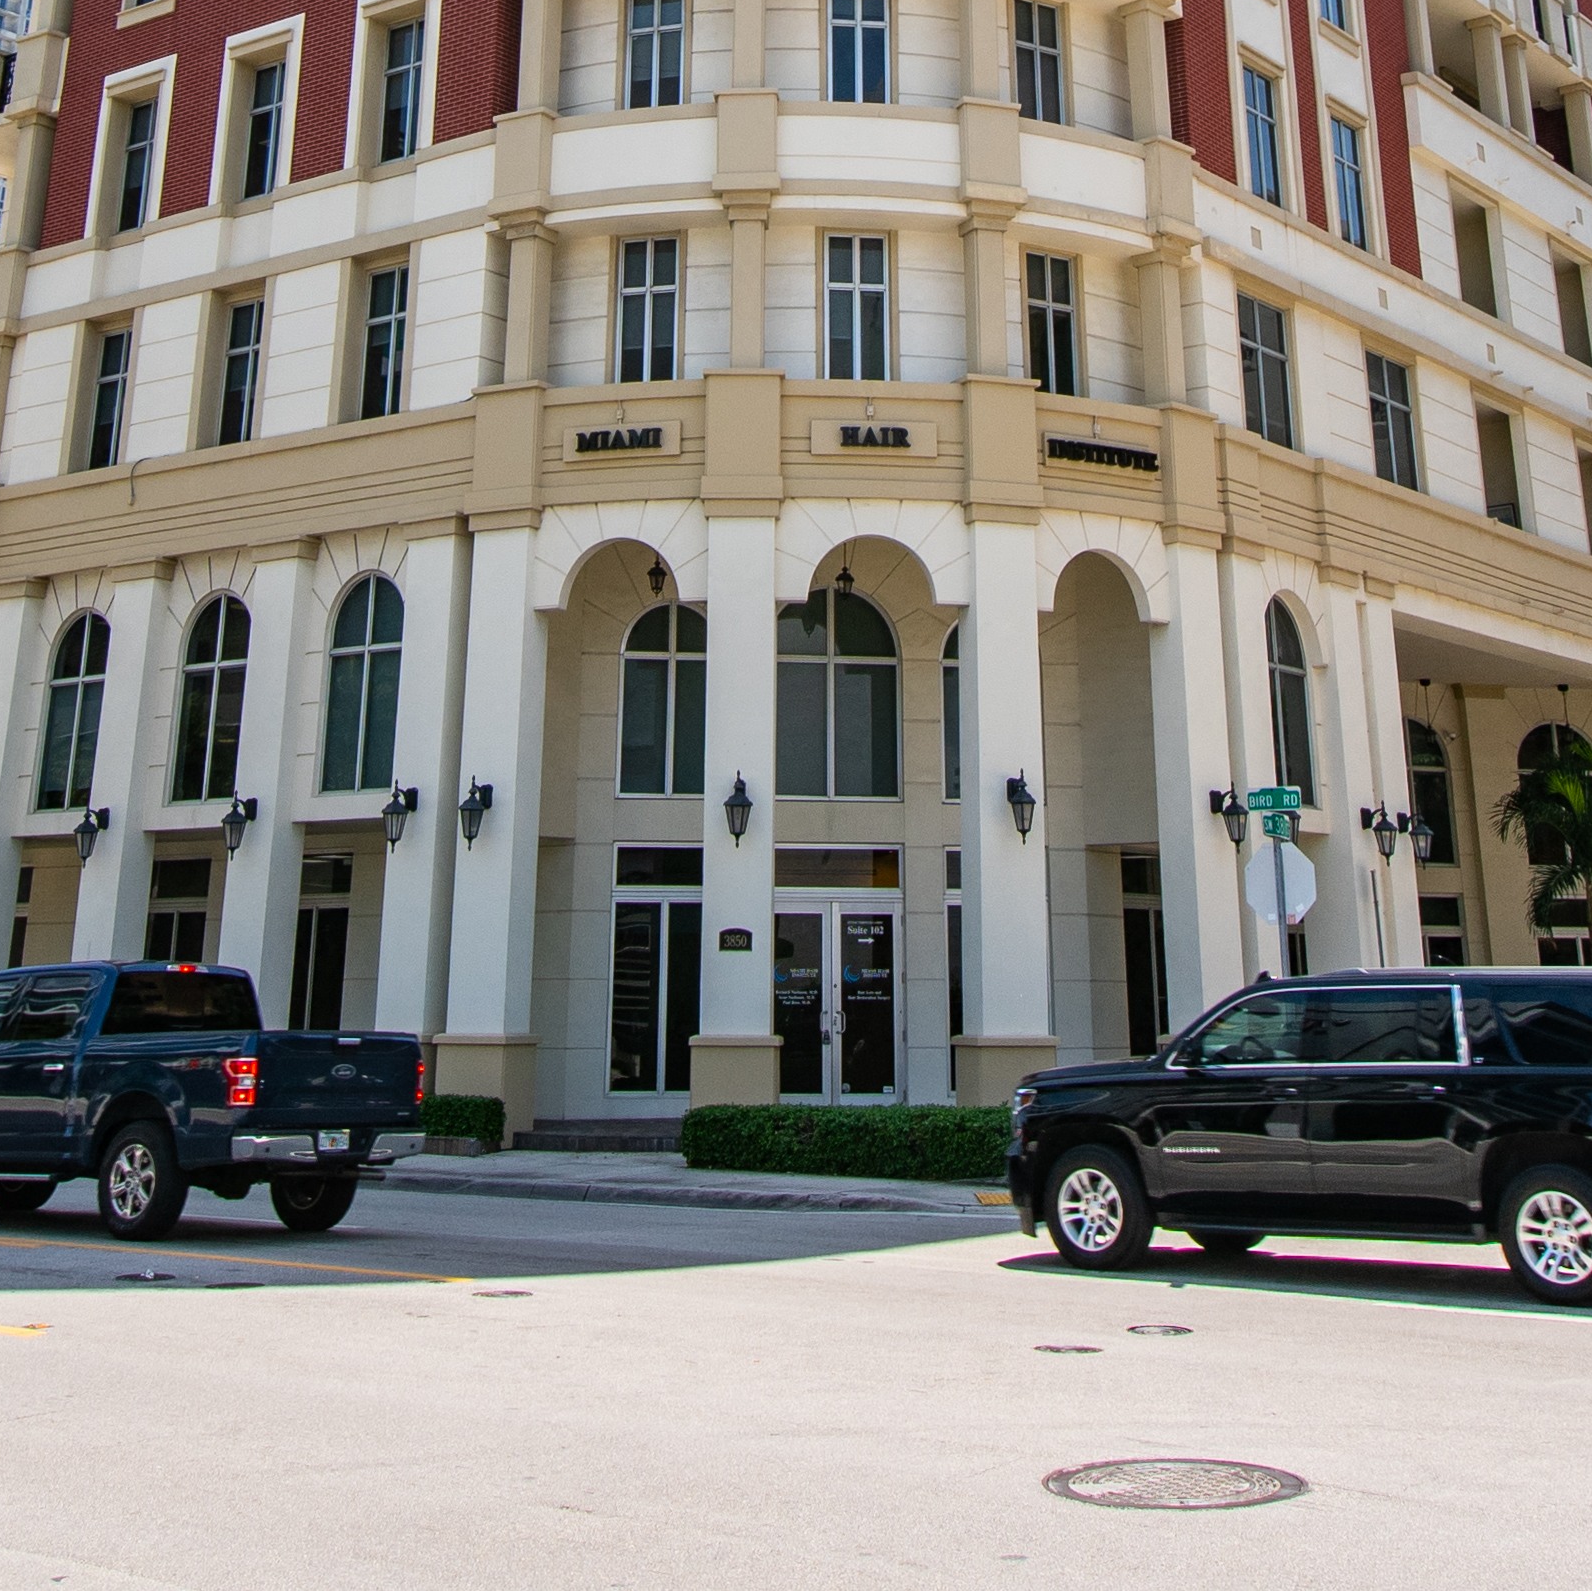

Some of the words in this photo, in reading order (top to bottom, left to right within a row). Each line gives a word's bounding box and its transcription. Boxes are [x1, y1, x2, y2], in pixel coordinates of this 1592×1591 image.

[575, 427, 663, 453] MIAMI
[839, 425, 911, 448] HAIR
[1249, 795, 1273, 808] BIRD
[1282, 794, 1298, 806] RD
[847, 925, 868, 935] Suite
[870, 925, 884, 935] 102
[723, 934, 748, 948] 3850
